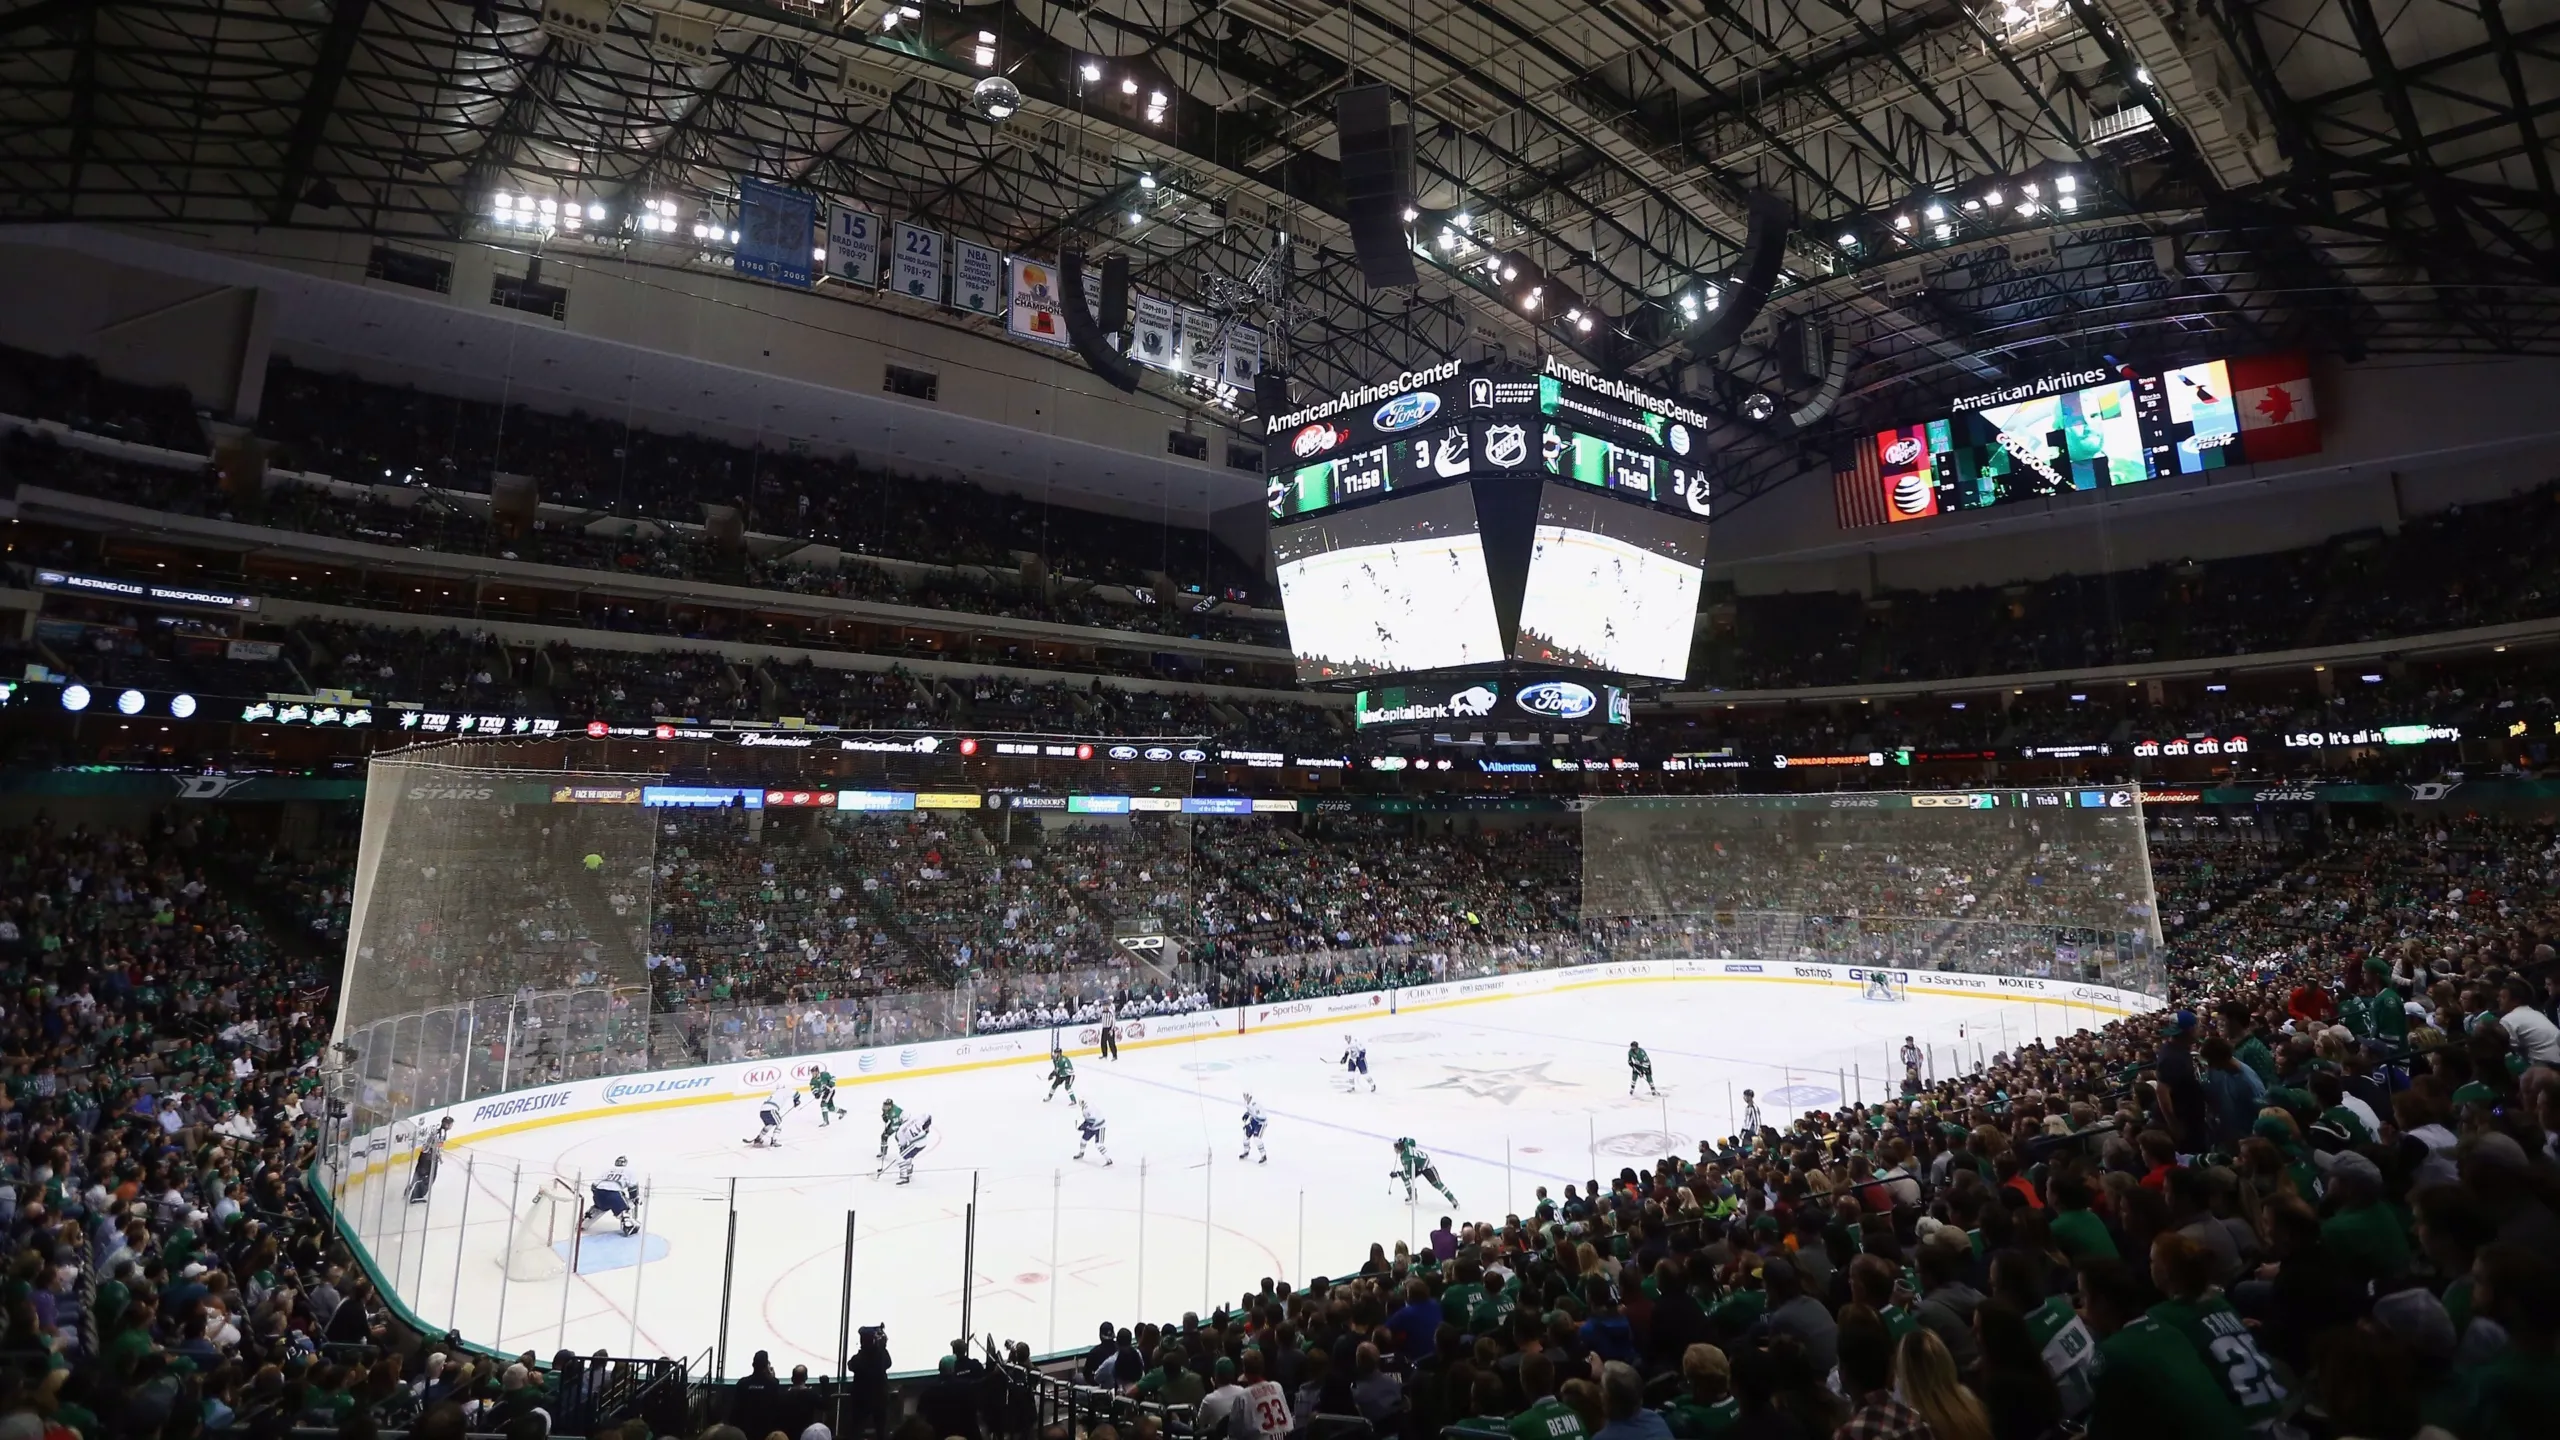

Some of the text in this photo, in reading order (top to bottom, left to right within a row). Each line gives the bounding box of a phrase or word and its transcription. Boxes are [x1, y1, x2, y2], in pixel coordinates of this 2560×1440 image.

[843, 213, 867, 239] 15
[832, 234, 874, 253] BRAD DAVIS
[906, 230, 932, 256] 22
[838, 246, 868, 261] 1980-92
[967, 249, 988, 262] NBA
[741, 260, 764, 271] 1980
[964, 258, 992, 271] MIDWEST
[784, 270, 806, 281] 2005
[964, 265, 992, 278] DIVISION
[959, 272, 996, 287] CHAMPIONS
[1018, 292, 1032, 302] 2011
[1139, 316, 1169, 331] CHAMPIONS
[1230, 343, 1257, 357] CHAMPIONS
[1266, 358, 1462, 435] AmericanAirlinesCenter
[1545, 354, 1709, 430] AmericanAirlinesCenter
[1951, 368, 2107, 412] American Airlines
[1386, 396, 1427, 427] Ford
[1493, 432, 1519, 458] NHL
[1898, 440, 1910, 452] Dr
[1414, 440, 1430, 469] 3
[1995, 433, 2063, 486] GOLIGOSKI
[1344, 469, 1380, 493] 11:58
[1673, 469, 1686, 495] 3
[68, 576, 117, 592] MUSTANG
[150, 588, 233, 605] TEXASFORD.COM
[1536, 688, 1582, 711] Ford
[1416, 704, 1449, 718] Bank
[422, 713, 451, 725] TXU
[479, 716, 506, 727] TXU
[534, 719, 560, 730] TXU
[421, 724, 447, 732] energy
[478, 726, 502, 734] energy
[739, 732, 812, 748] Budweiser
[2285, 733, 2324, 747] LSO
[2329, 732, 2351, 745] It's
[2353, 730, 2367, 744] all
[2370, 729, 2382, 742] in
[2134, 744, 2158, 757] citi
[2163, 743, 2188, 756] citi
[2193, 742, 2218, 755] citi
[2223, 741, 2248, 753] citi
[1297, 757, 1344, 768] American Airlines
[1489, 761, 1536, 772] Albertsons
[1663, 760, 1686, 771] SER
[1787, 757, 1826, 766] DOWNLOAD
[1854, 756, 1869, 764] APP
[408, 787, 494, 801] STARS
[575, 790, 587, 798] FACE
[587, 790, 596, 798] THE
[2135, 790, 2200, 804] Budweiser
[2254, 791, 2316, 801] STARS
[1023, 797, 1066, 806] BACHENDORF'S
[1317, 803, 1352, 812] STARS
[1830, 799, 1879, 808] STARS
[1609, 967, 1623, 976] KIA
[1632, 966, 1648, 975] KIA
[1935, 976, 1986, 988] Sandman
[1999, 978, 2044, 990] MOXIE'S
[1410, 986, 1450, 1000] CHOCTAW
[1272, 1002, 1313, 1017] SportsDay
[1156, 1023, 1187, 1034] American
[1187, 1019, 1211, 1030] Airlines
[956, 1044, 971, 1056] citi
[750, 1070, 775, 1082] KIA
[610, 1077, 716, 1098] BUD LIGHT
[473, 1091, 573, 1122] PROGRESSIVE
[1257, 1399, 1287, 1430] 33
[1546, 1413, 1581, 1438] BENN
